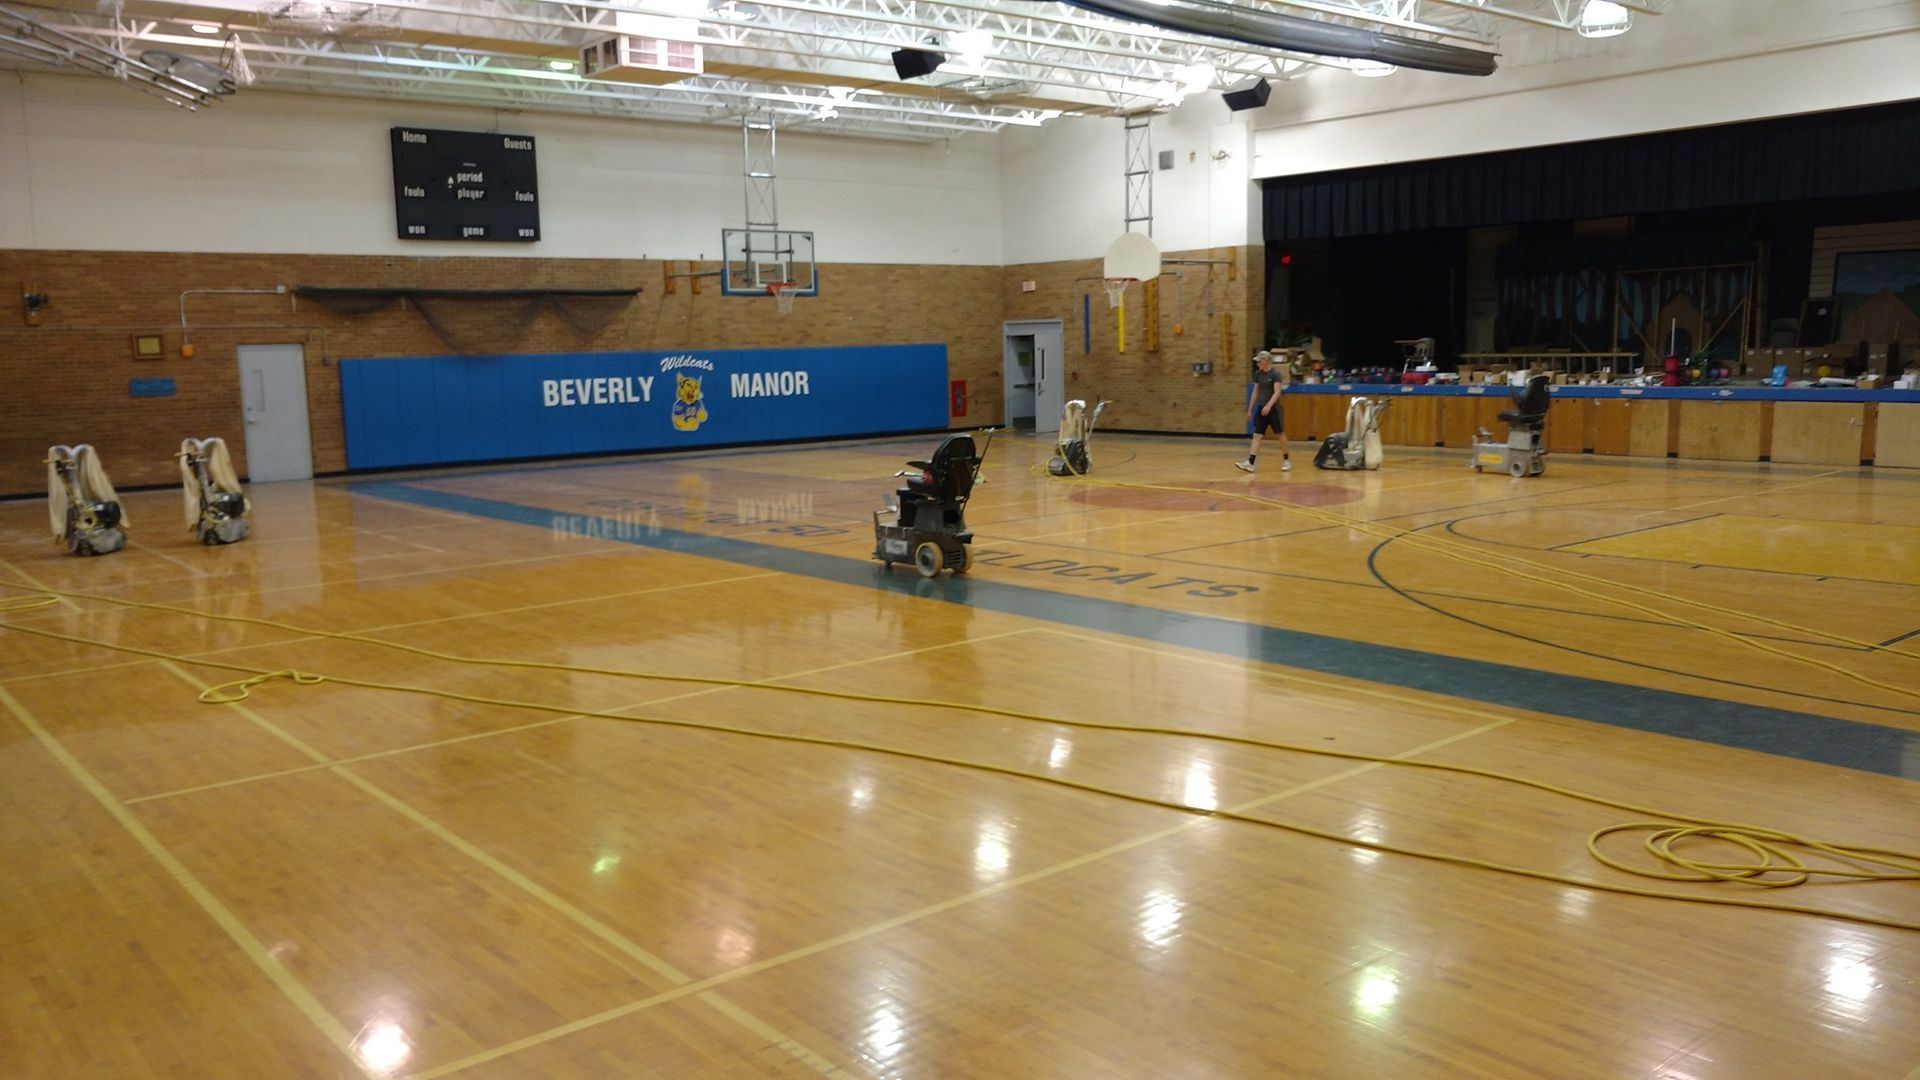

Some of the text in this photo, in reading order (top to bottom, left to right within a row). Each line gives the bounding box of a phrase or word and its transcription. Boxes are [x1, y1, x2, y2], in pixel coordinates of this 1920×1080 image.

[402, 130, 427, 144] Home
[504, 137, 533, 151] Guests
[456, 171, 483, 184] period
[404, 185, 426, 198] fouls
[457, 187, 485, 200] player
[515, 190, 535, 203] fouls
[408, 225, 426, 235] won
[463, 226, 485, 238] game
[518, 228, 535, 238] won
[659, 354, 715, 374] Wildcats
[542, 370, 810, 407] BEVERLY MANOR
